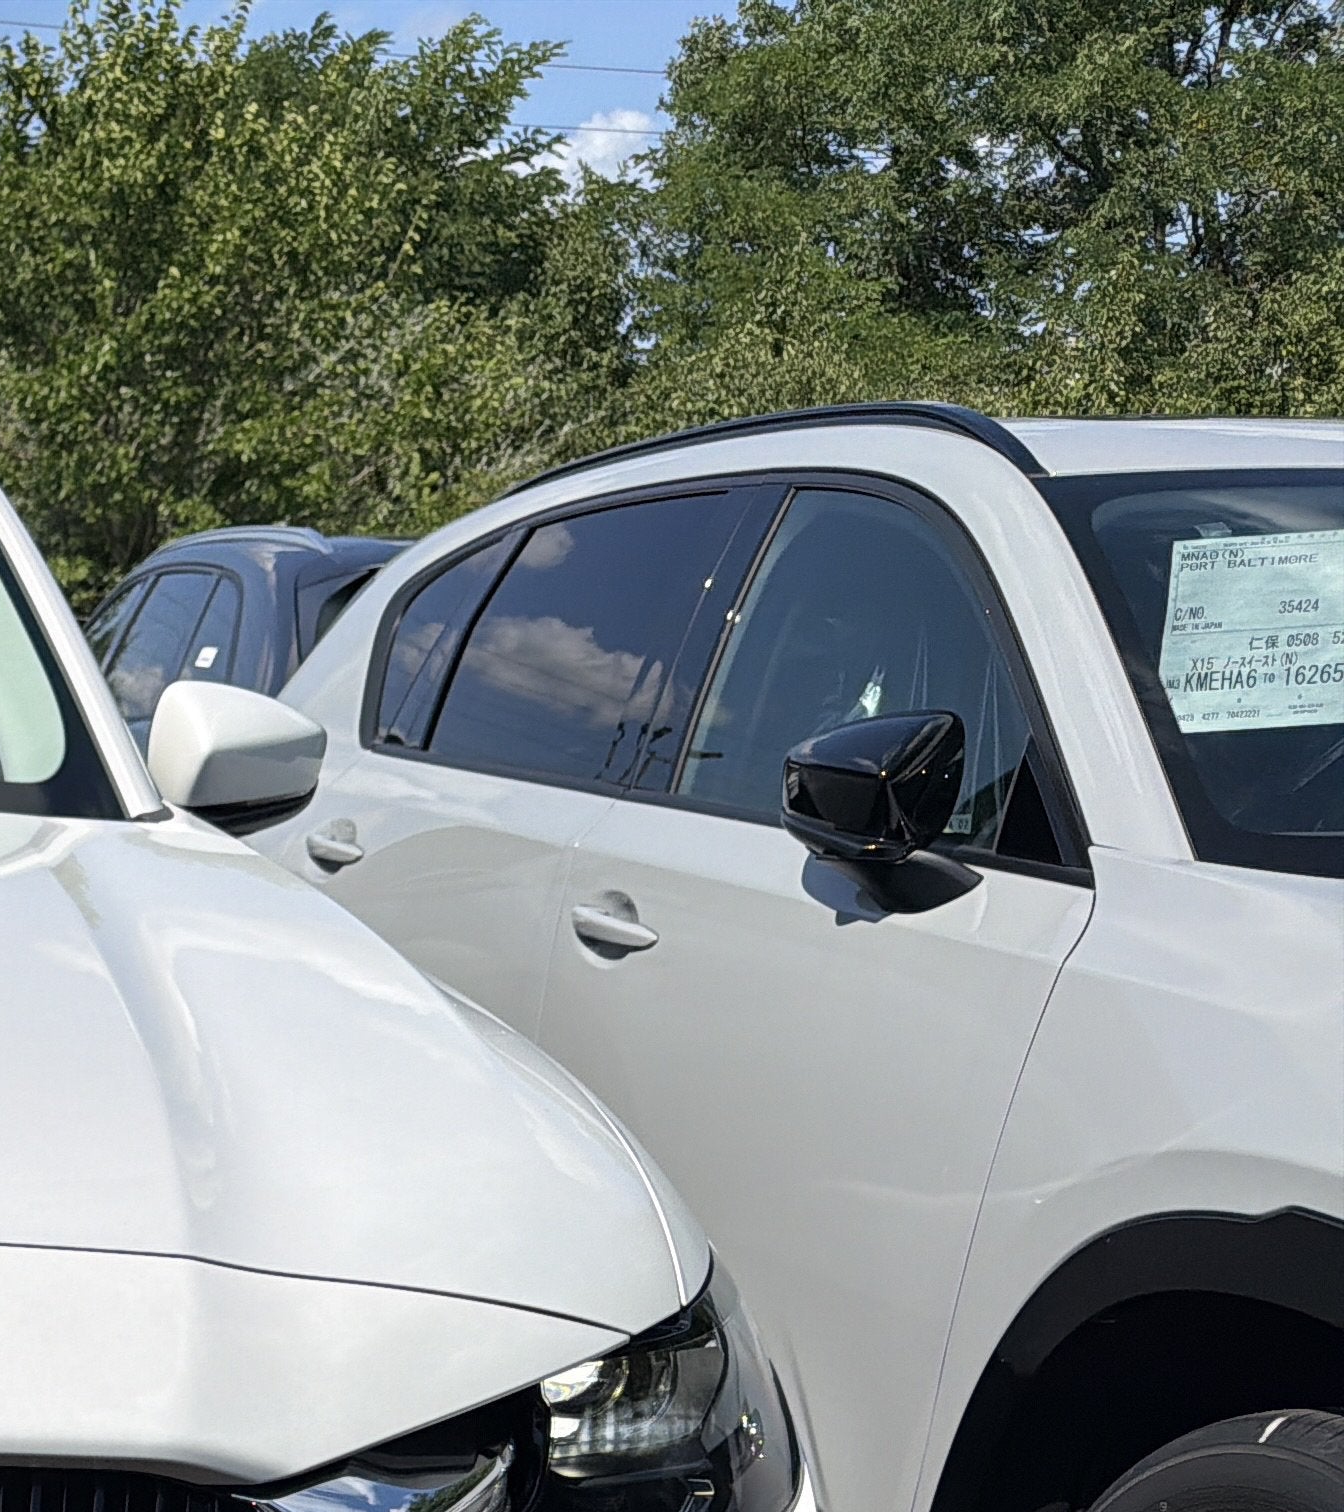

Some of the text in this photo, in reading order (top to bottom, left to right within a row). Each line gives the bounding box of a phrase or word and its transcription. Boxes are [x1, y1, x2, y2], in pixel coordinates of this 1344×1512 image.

[1180, 553, 1319, 572] PORT BALTIMORE
[1278, 598, 1320, 614] 35424
[1201, 621, 1223, 631] JAPAN
[1286, 632, 1320, 648] 0508
[1190, 656, 1214, 673] X15
[1183, 667, 1258, 694] KMEHA6
